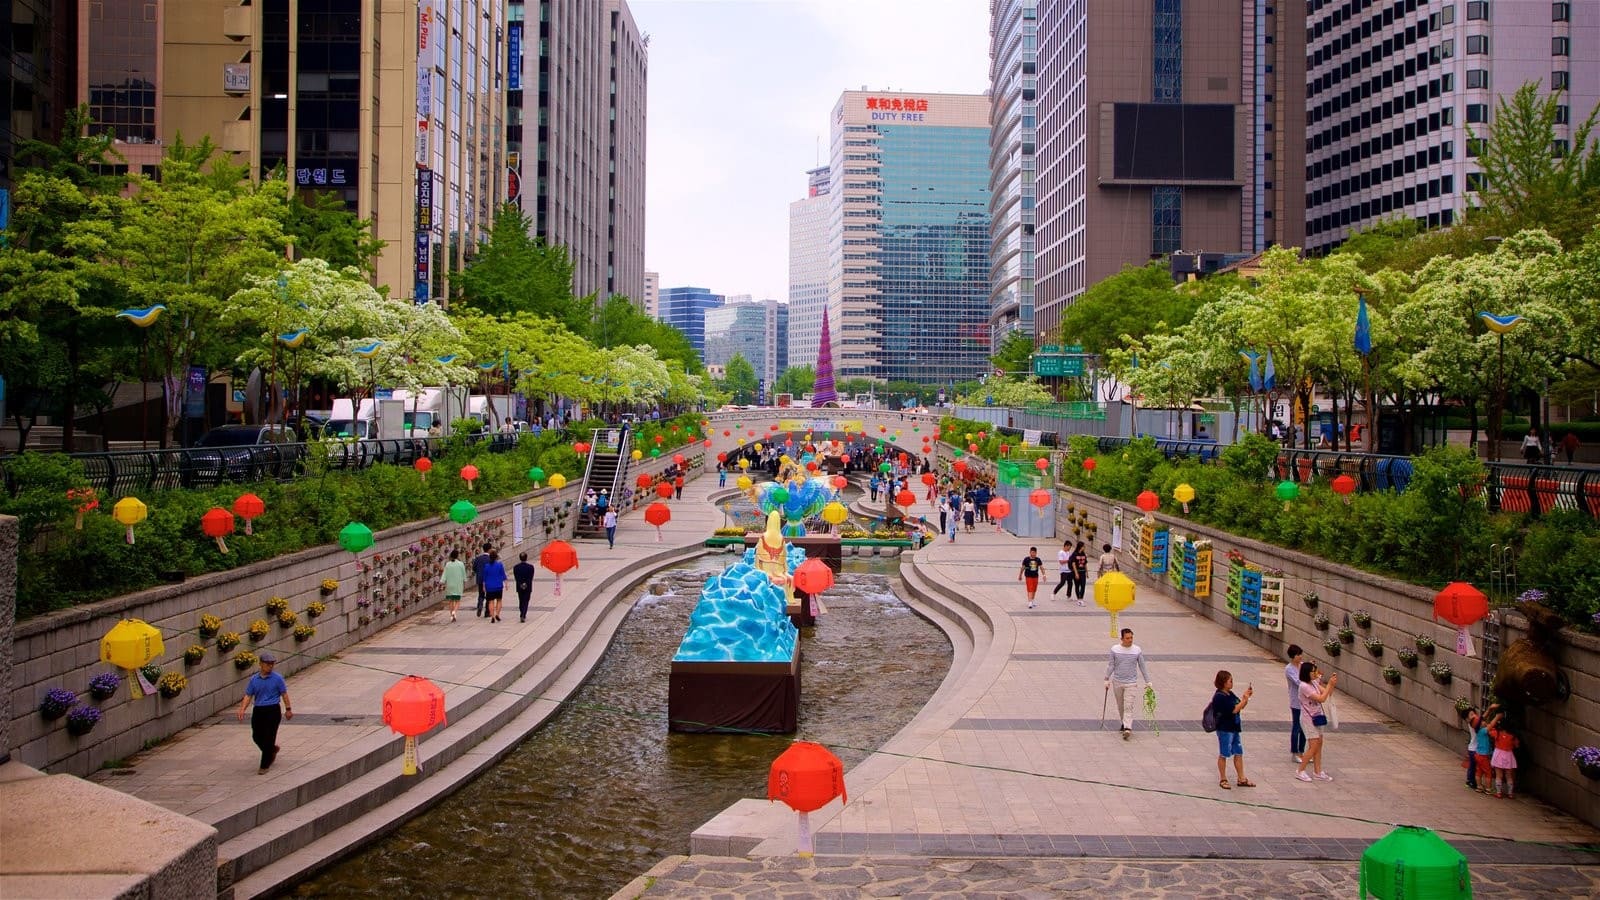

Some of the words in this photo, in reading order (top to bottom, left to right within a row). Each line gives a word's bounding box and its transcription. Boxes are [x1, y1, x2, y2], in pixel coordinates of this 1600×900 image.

[226, 74, 248, 87] 내과
[871, 112, 897, 120] DUTY
[901, 113, 924, 122] FREE
